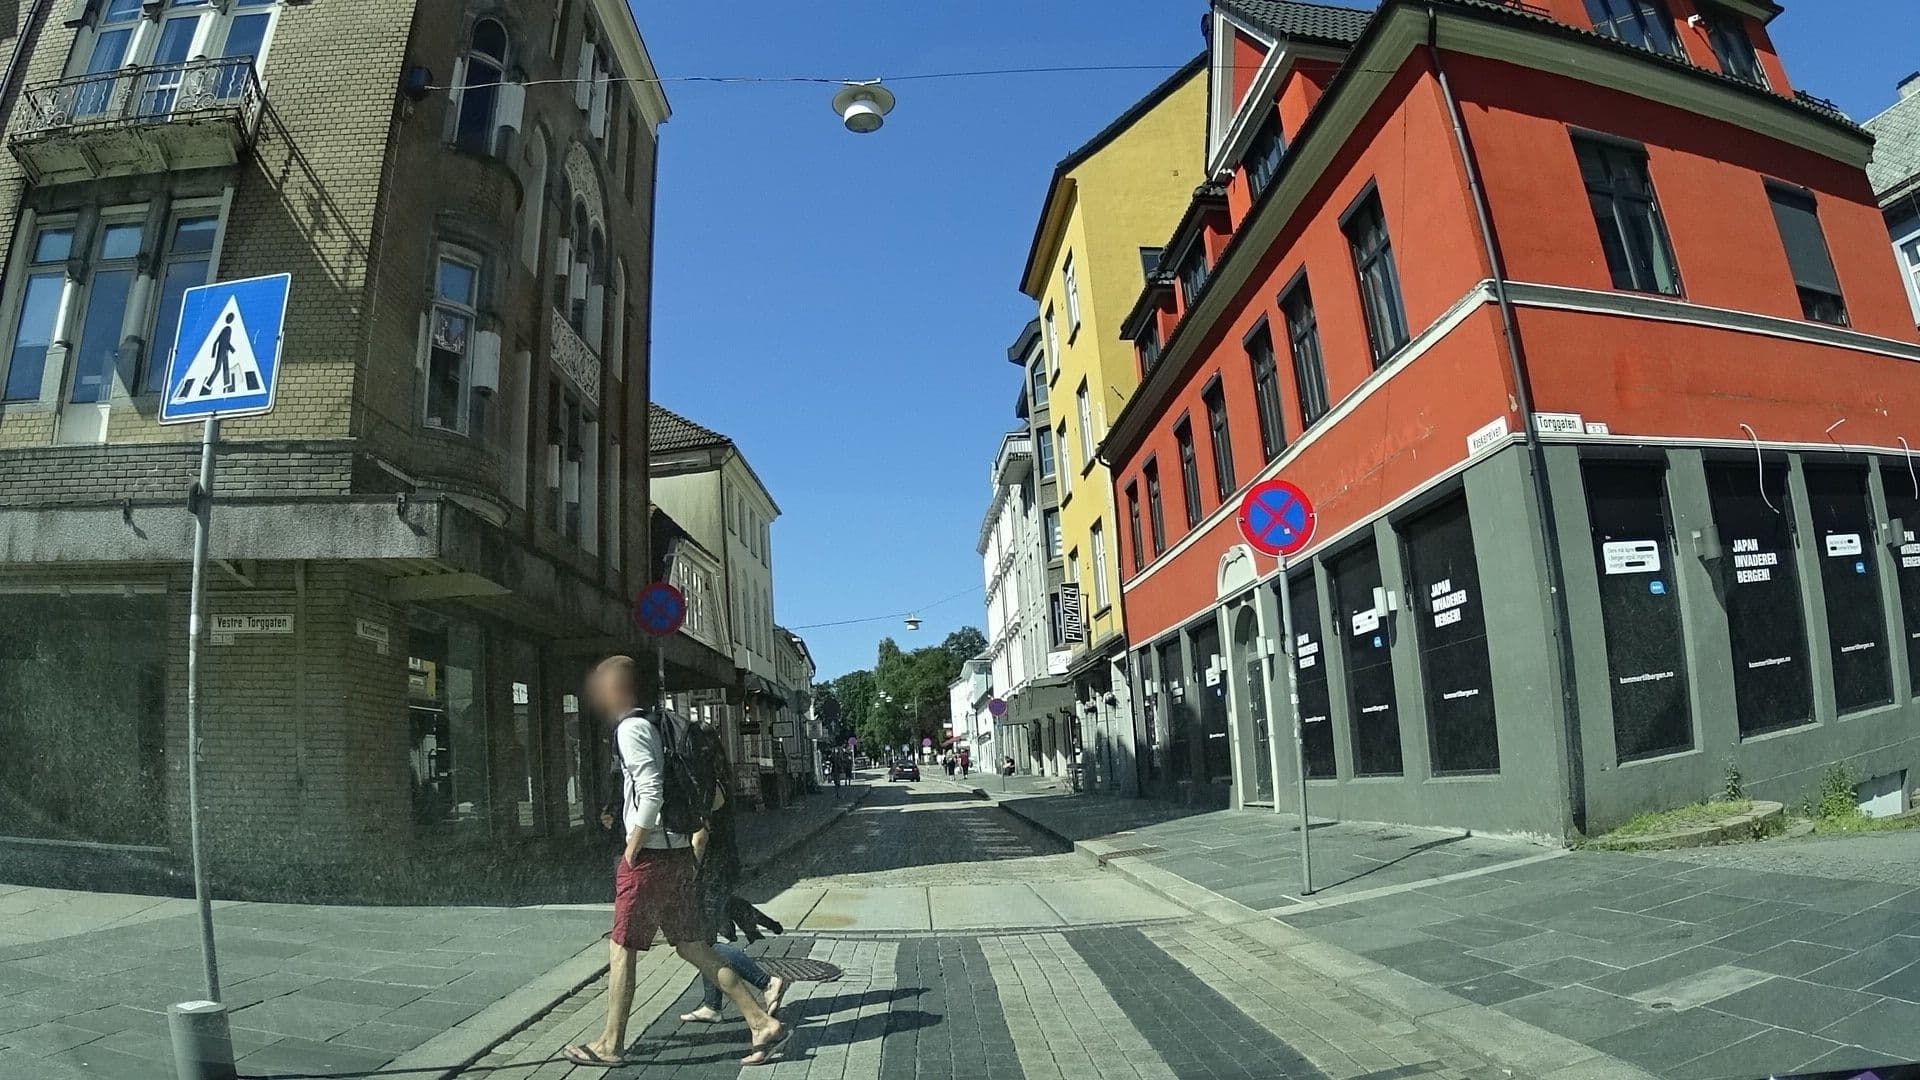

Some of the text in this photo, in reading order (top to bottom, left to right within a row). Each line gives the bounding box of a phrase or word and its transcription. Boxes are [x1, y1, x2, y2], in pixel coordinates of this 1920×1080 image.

[1537, 416, 1577, 432] Torggaten
[1733, 538, 1758, 552] JAPAN
[1734, 553, 1777, 568] INVADERER
[1737, 568, 1771, 584] BERGEN!
[1431, 579, 1451, 598] JAPAN
[1063, 587, 1083, 641] PINGVINEN
[217, 616, 287, 630] Vestre Torggaten
